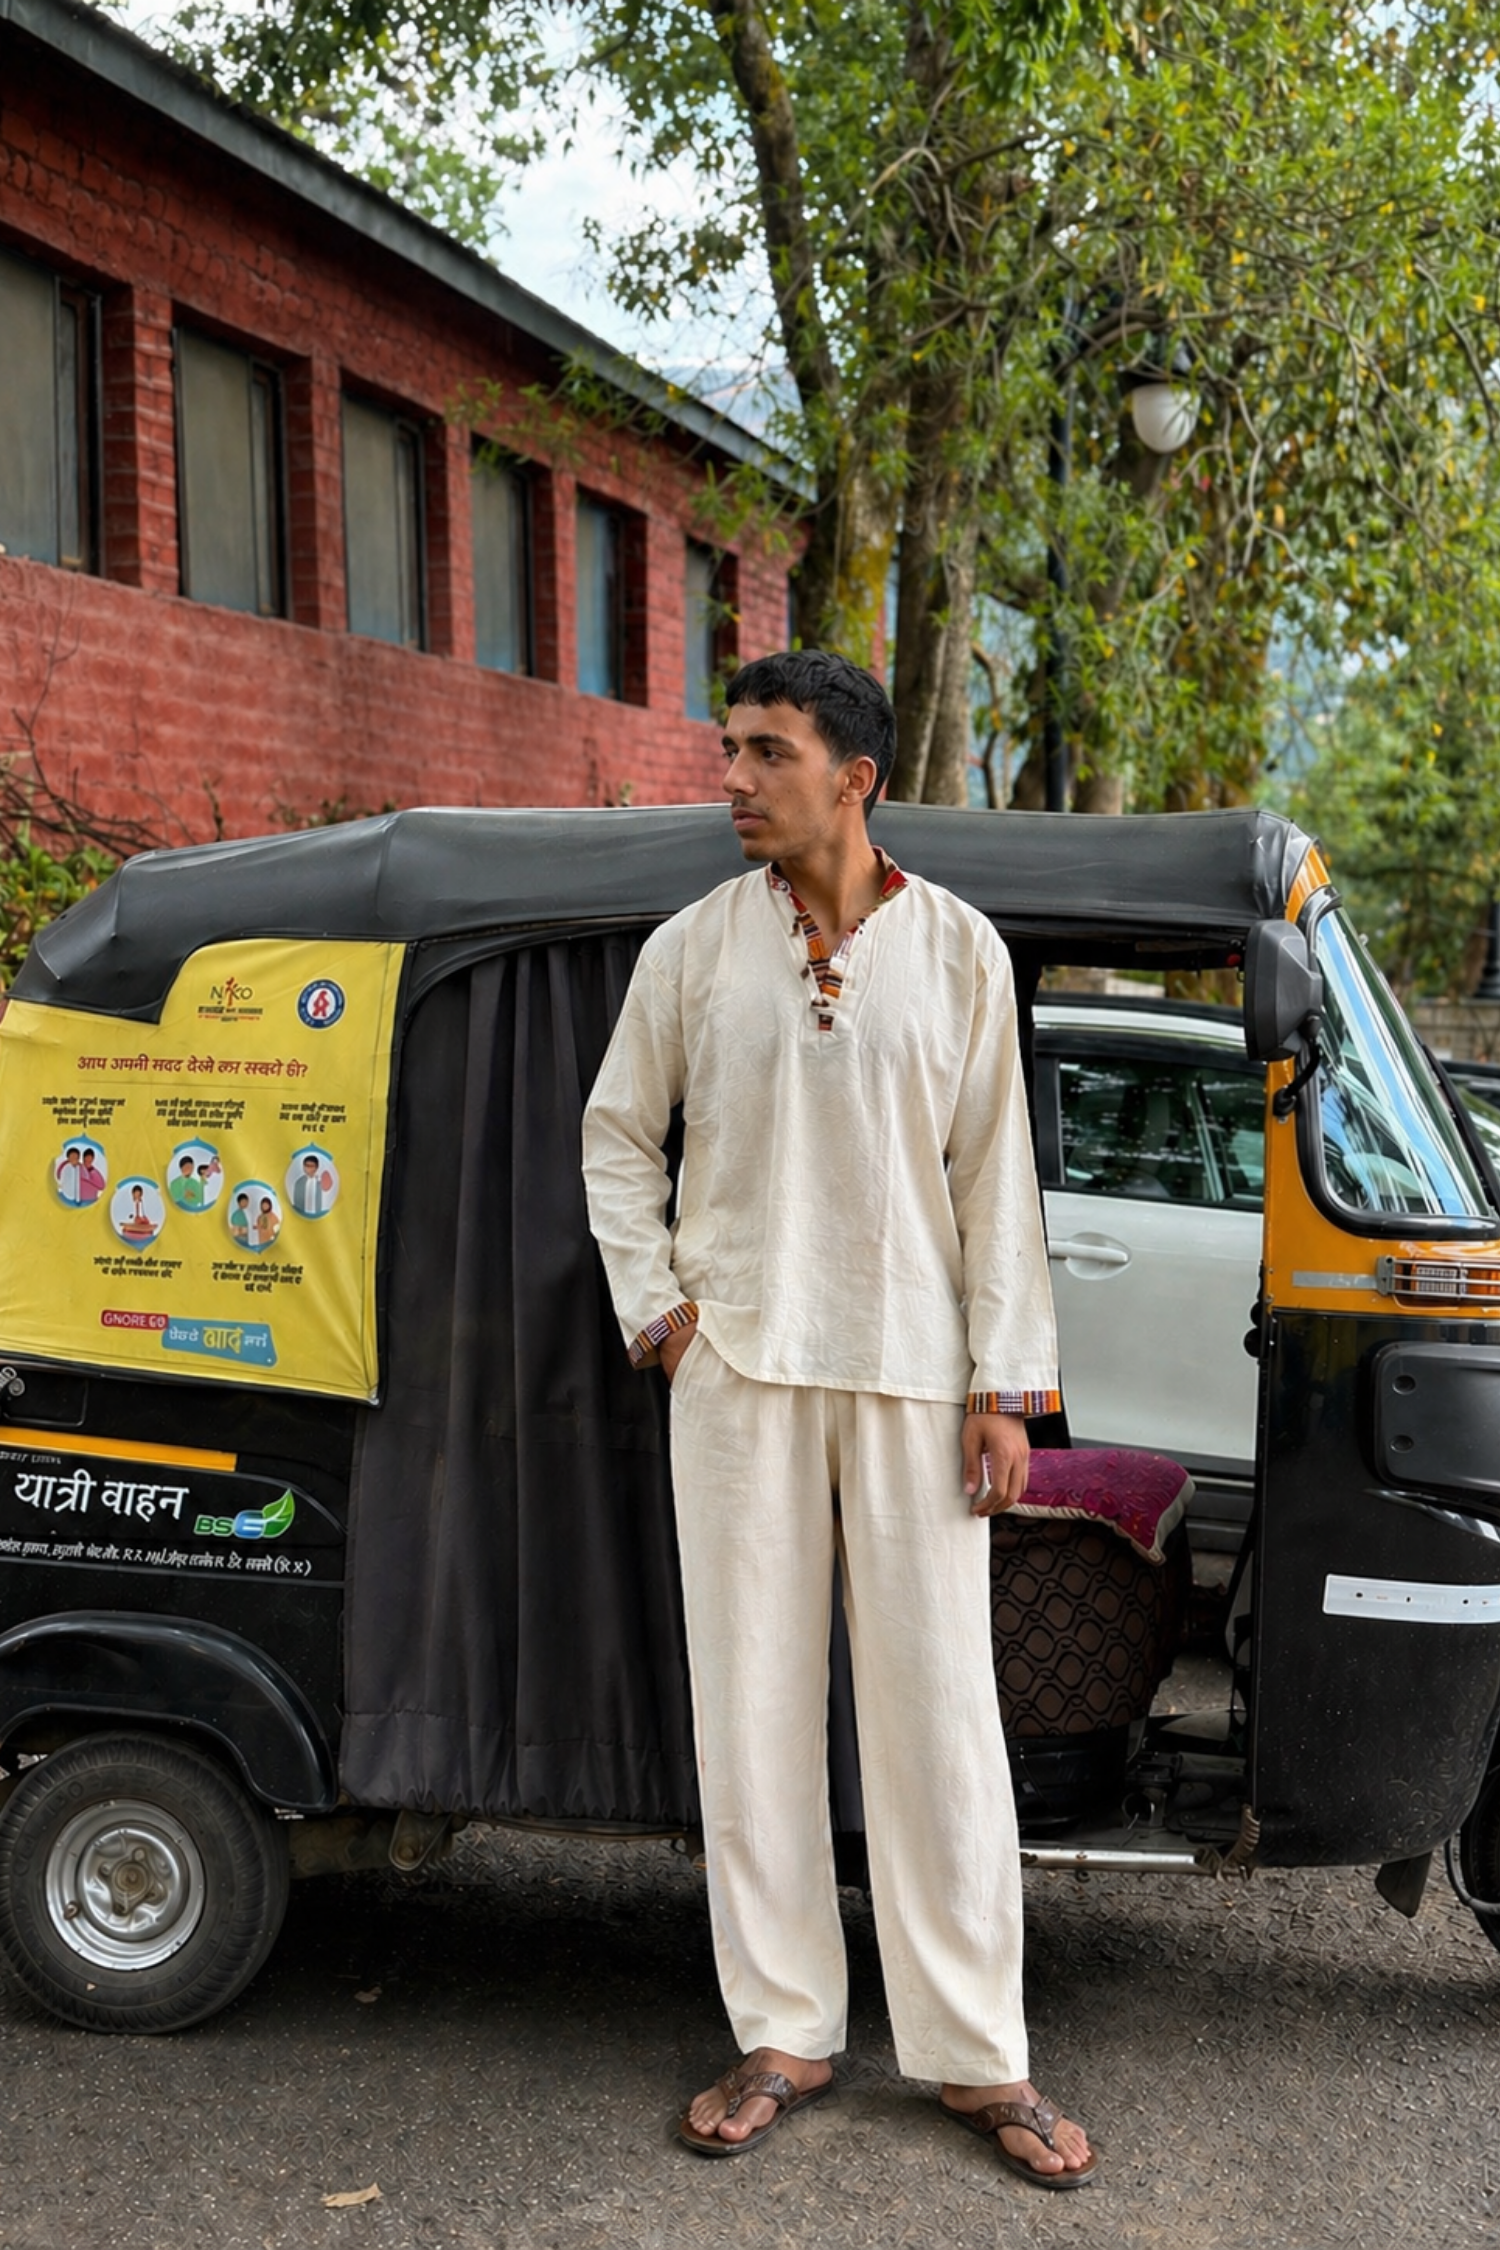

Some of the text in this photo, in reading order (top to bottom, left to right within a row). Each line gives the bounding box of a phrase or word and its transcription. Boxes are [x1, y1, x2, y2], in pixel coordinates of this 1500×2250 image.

[77, 1056, 108, 1070] आप
[14, 1468, 190, 1523] यात्री वाहन
